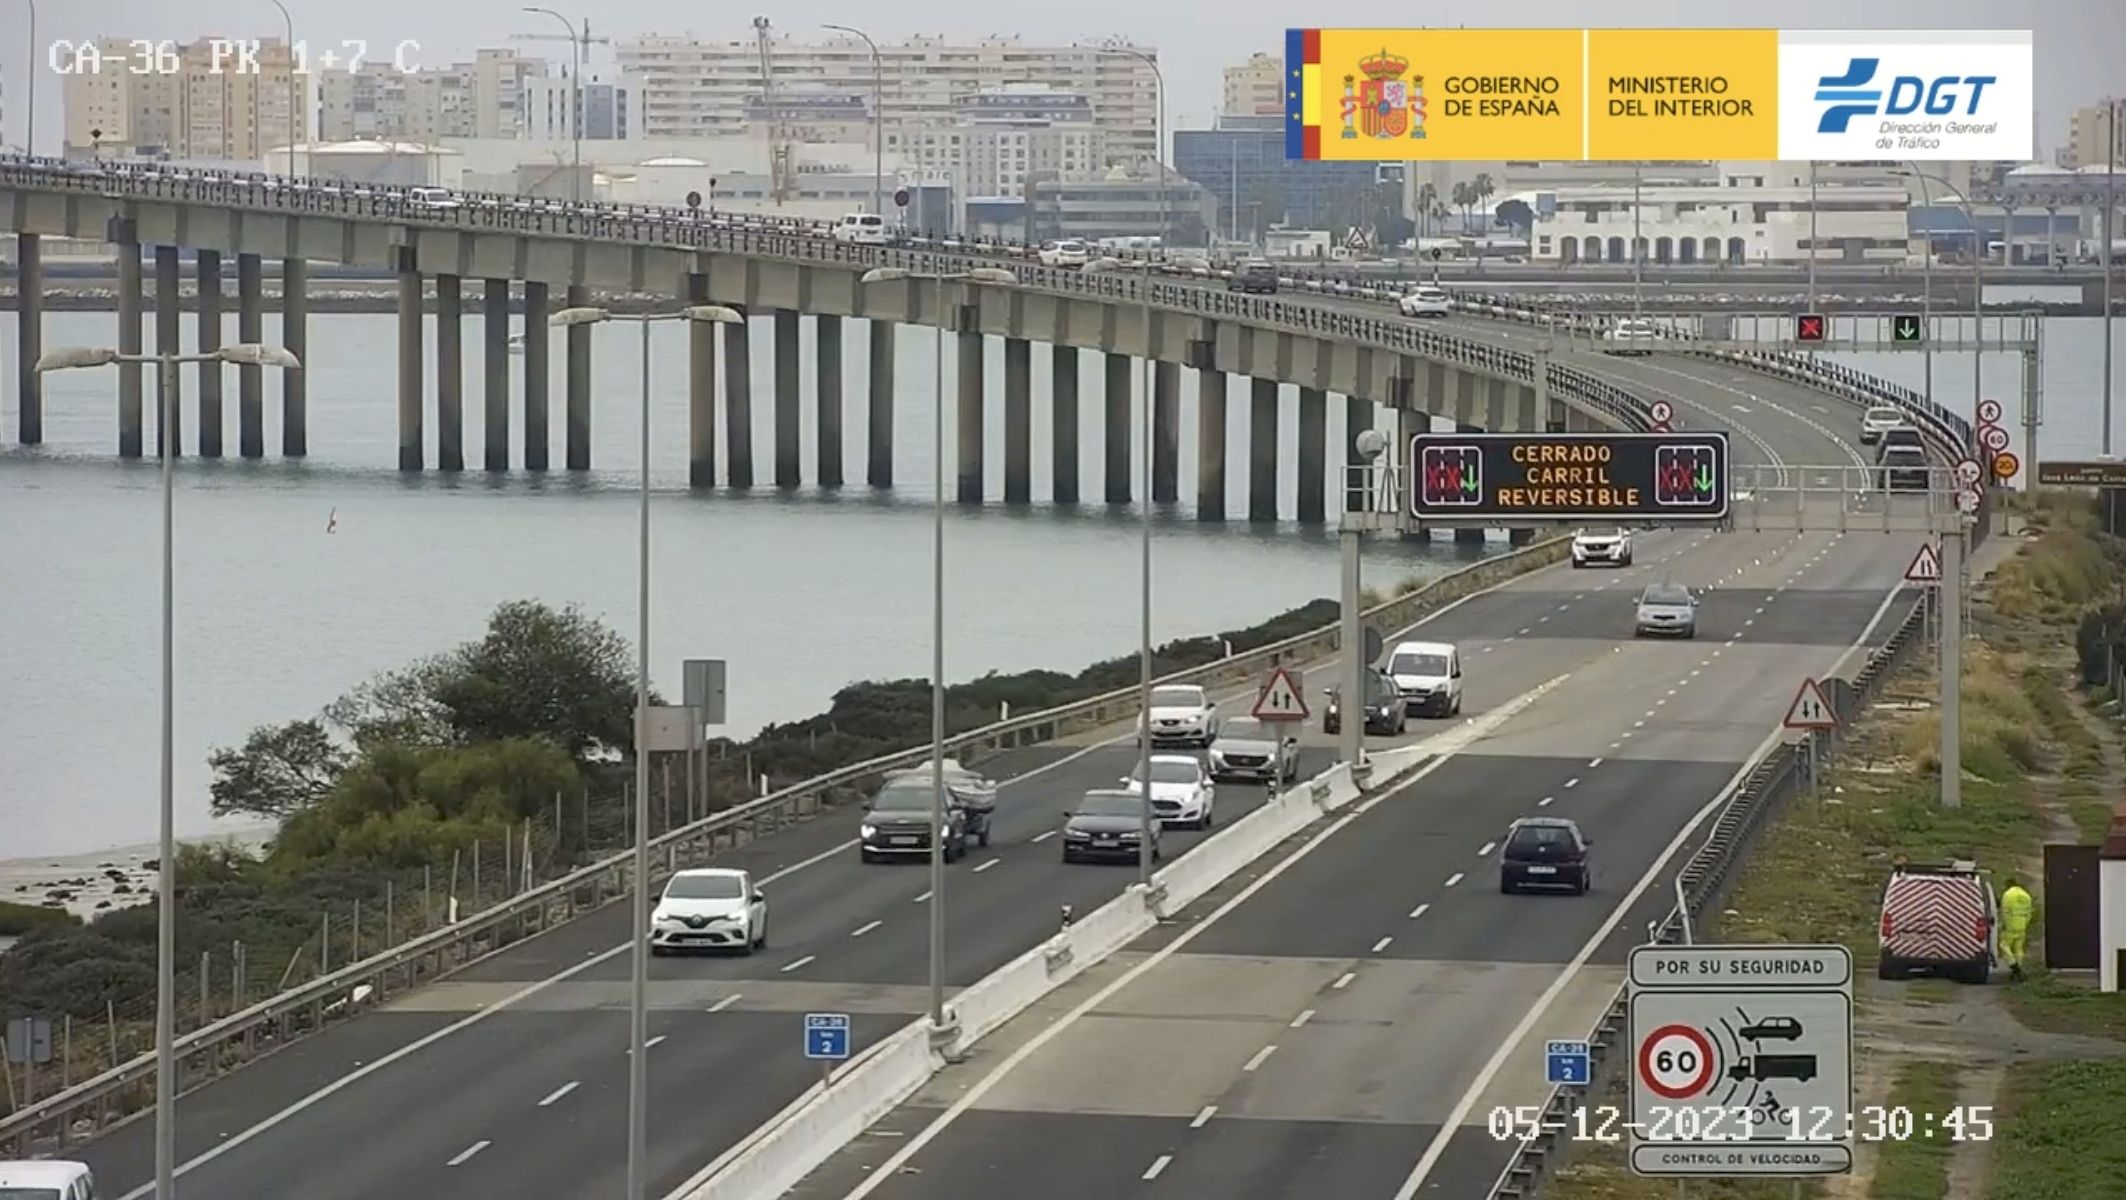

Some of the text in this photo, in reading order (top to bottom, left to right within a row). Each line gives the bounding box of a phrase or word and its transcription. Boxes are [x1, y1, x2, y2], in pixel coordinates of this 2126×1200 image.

[1512, 446, 1611, 462] CERRADO
[1527, 468, 1610, 484] CARRIL
[1498, 489, 1639, 506] REVERSIBLE
[1656, 959, 1825, 975] POR SU SEGURIDAD
[822, 1041, 832, 1053] 2
[1656, 1050, 1697, 1074] 60
[1562, 1067, 1573, 1080] 2
[1662, 1153, 1821, 1165] CONTROL DE VELOCIDAD
